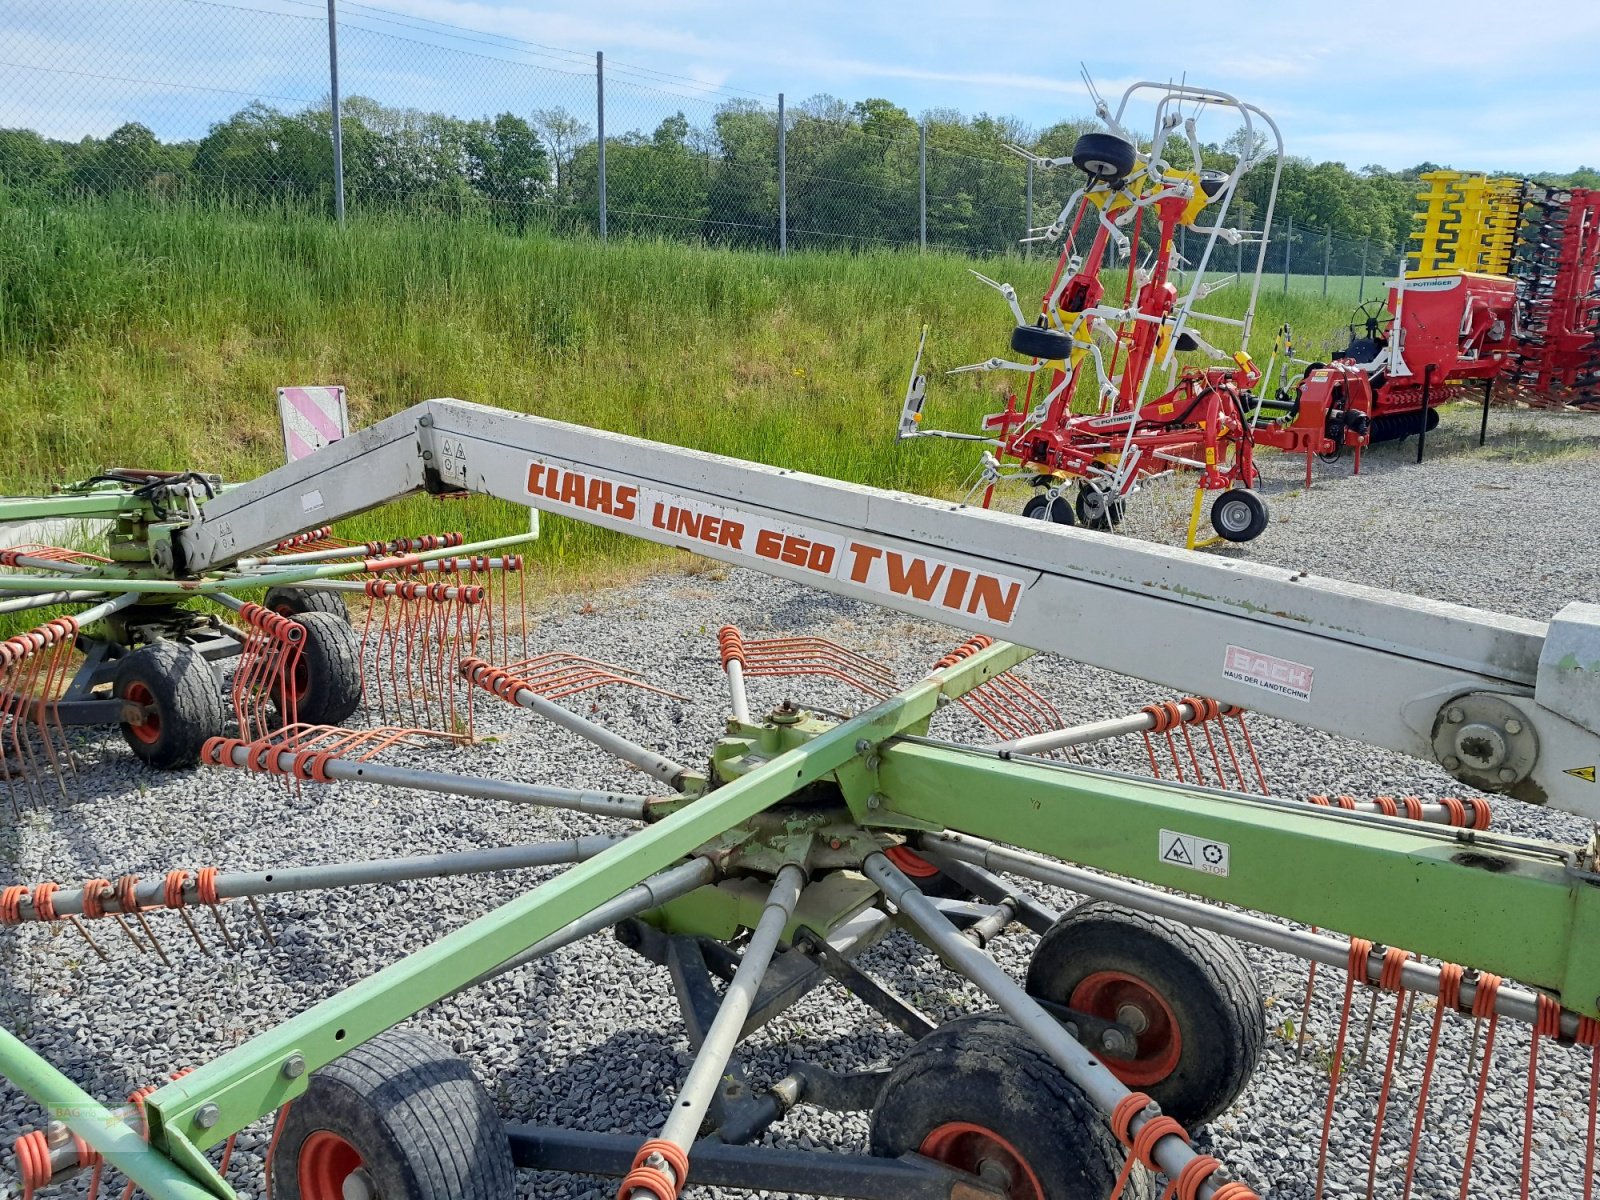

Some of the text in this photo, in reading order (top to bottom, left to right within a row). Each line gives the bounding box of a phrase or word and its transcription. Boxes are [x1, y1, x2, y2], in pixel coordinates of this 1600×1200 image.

[528, 463, 637, 520] CLAAS
[652, 502, 836, 574] LINER 650
[850, 542, 1021, 623] TWIN
[1224, 670, 1308, 699] HAUS DER LANDTECHNIK
[1202, 863, 1226, 875] STOP
